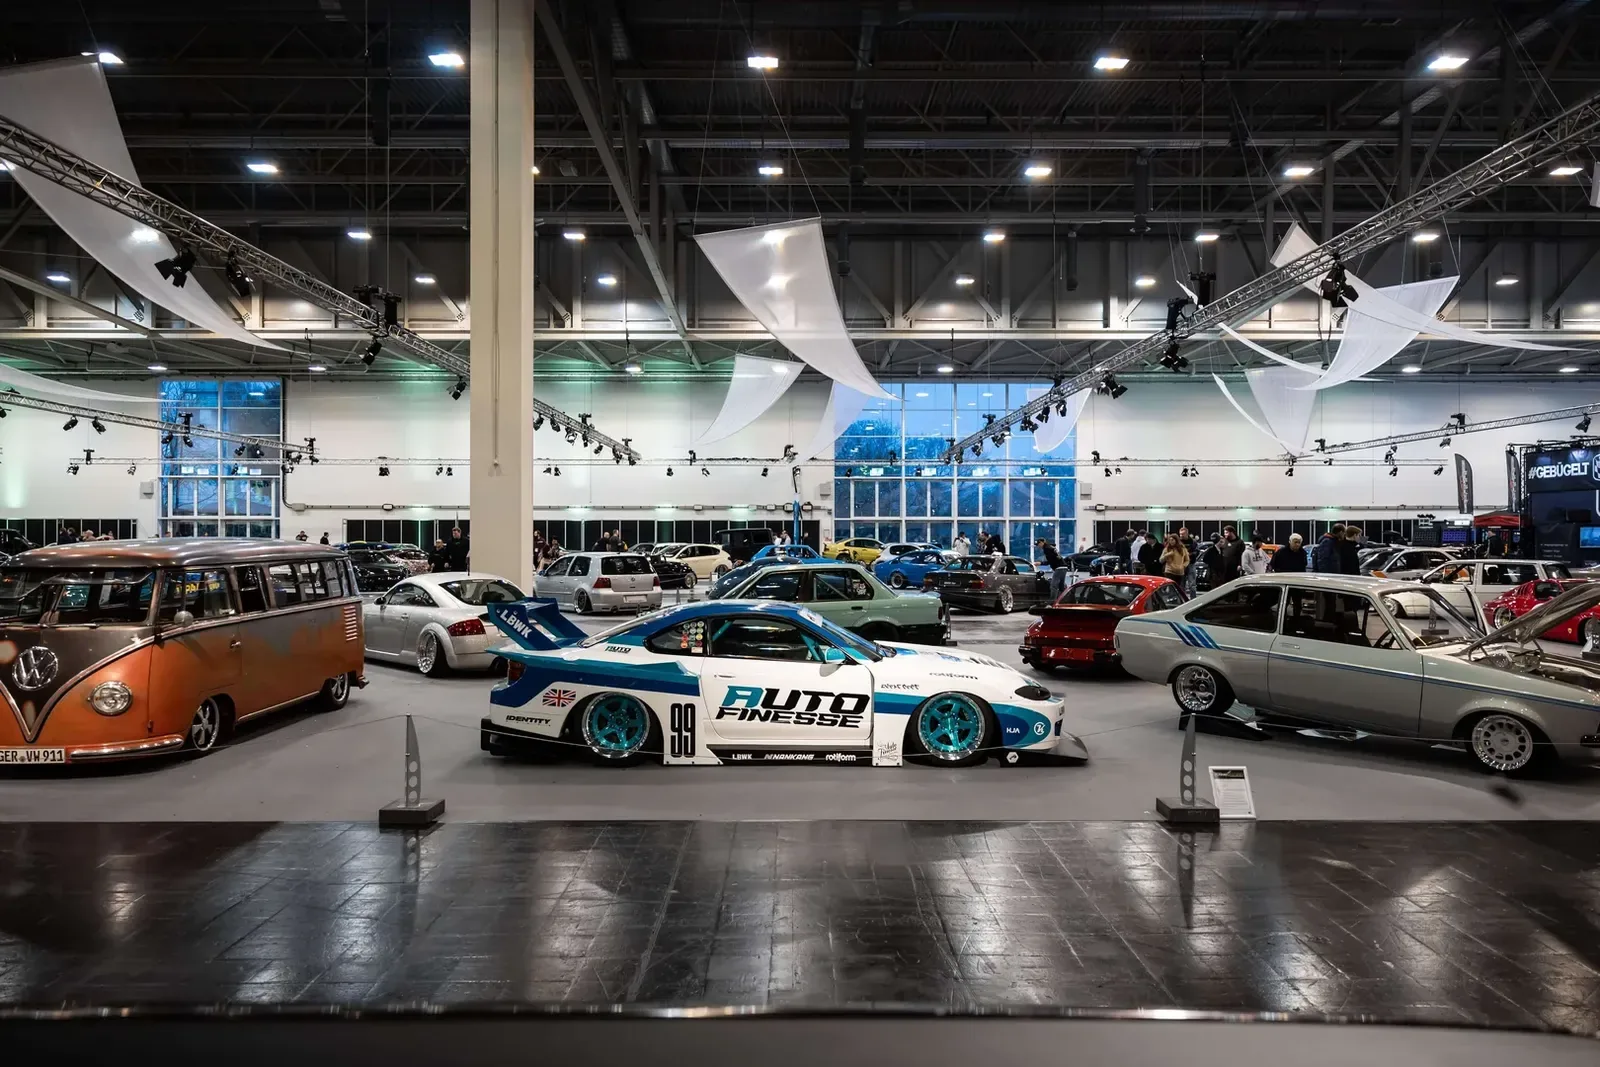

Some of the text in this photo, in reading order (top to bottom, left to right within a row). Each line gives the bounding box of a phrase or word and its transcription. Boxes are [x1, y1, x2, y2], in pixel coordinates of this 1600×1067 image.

[1528, 461, 1590, 479] #GEBÜGELT
[500, 609, 533, 639] LBWK
[721, 685, 870, 715] AUTO
[506, 714, 552, 725] IDENTITY
[715, 706, 864, 728] FINESSE
[670, 702, 696, 758] 99
[43, 750, 64, 762] 911
[825, 752, 857, 762] rotiform
